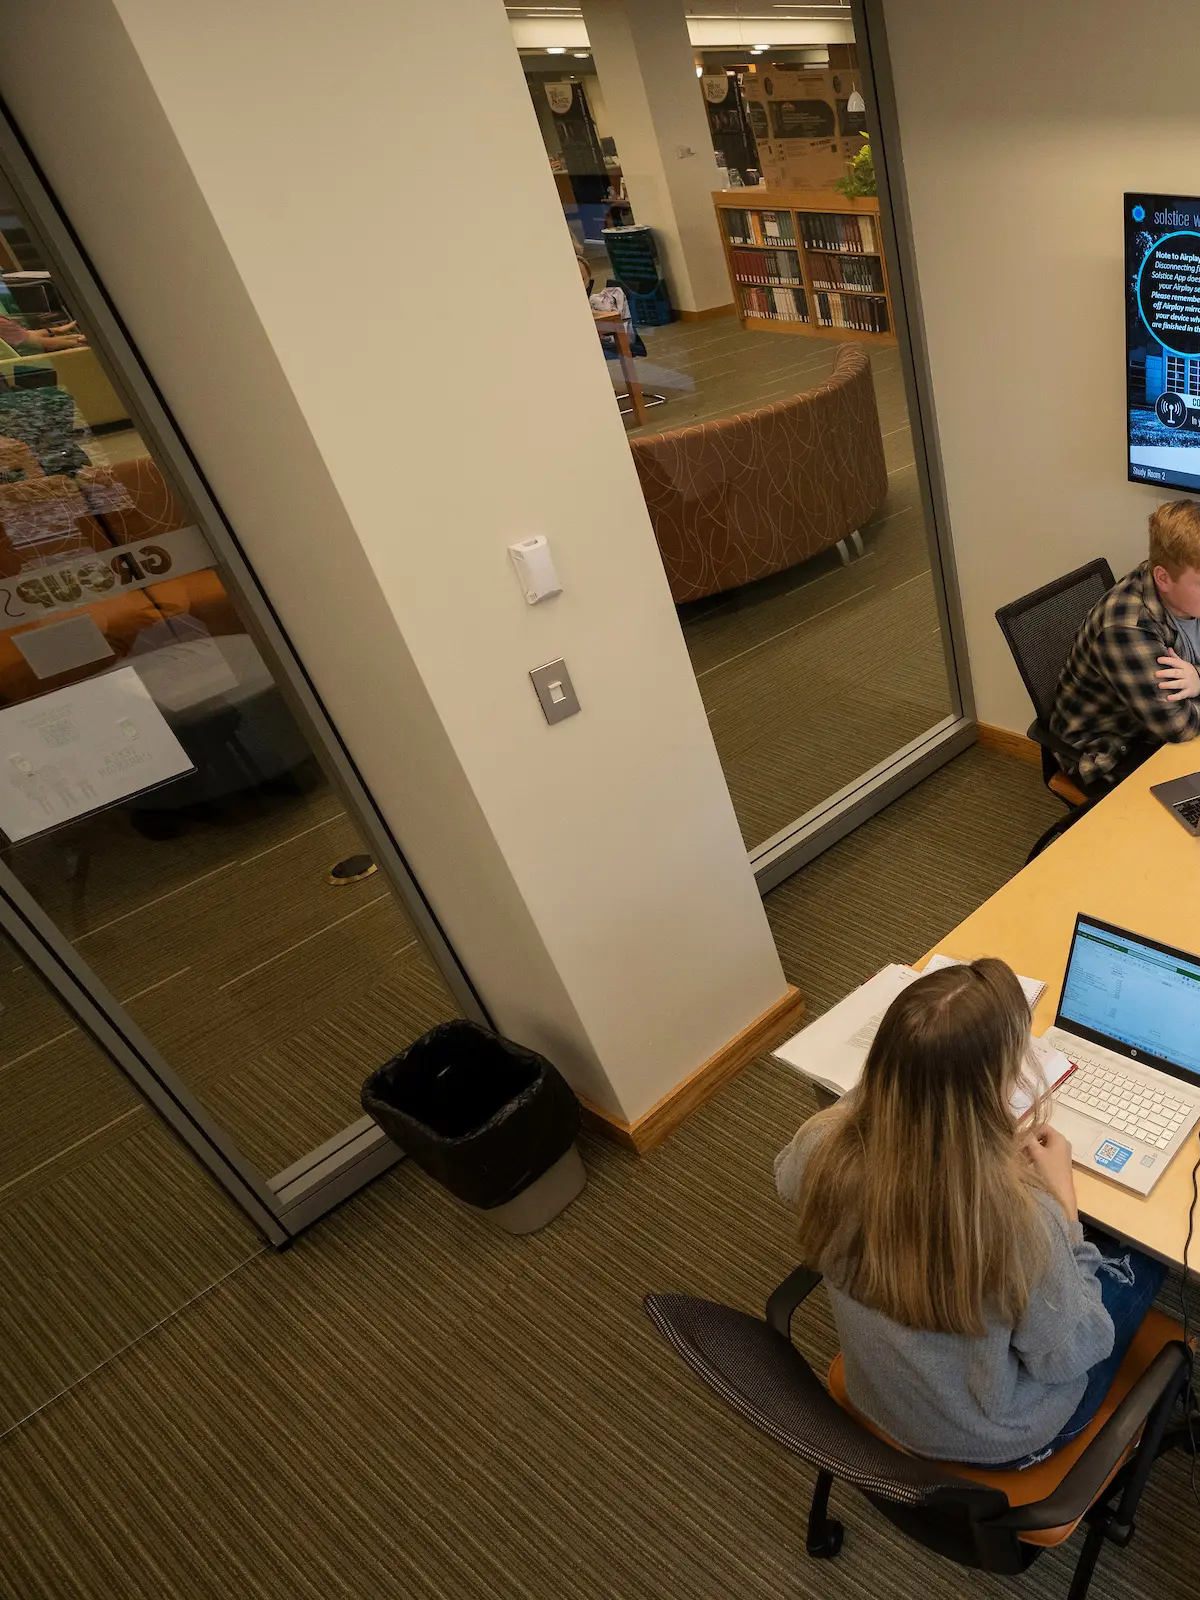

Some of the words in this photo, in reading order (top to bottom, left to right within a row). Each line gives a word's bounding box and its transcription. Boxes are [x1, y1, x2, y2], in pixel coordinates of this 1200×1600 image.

[1154, 208, 1190, 226] solstice
[1155, 251, 1171, 259] Note
[1155, 261, 1195, 273] Disconnecting
[1151, 271, 1173, 280] Solstice
[1174, 274, 1186, 282] App
[1173, 283, 1193, 293] Airplay
[1151, 291, 1171, 300] Please
[1153, 301, 1162, 310] off
[1162, 303, 1184, 312] Airplay
[1170, 313, 1189, 322] device
[1162, 322, 1186, 331] finished
[1191, 416, 1197, 425] In
[1133, 466, 1146, 478] Study
[1147, 469, 1160, 479] Room
[1162, 472, 1166, 480] 2
